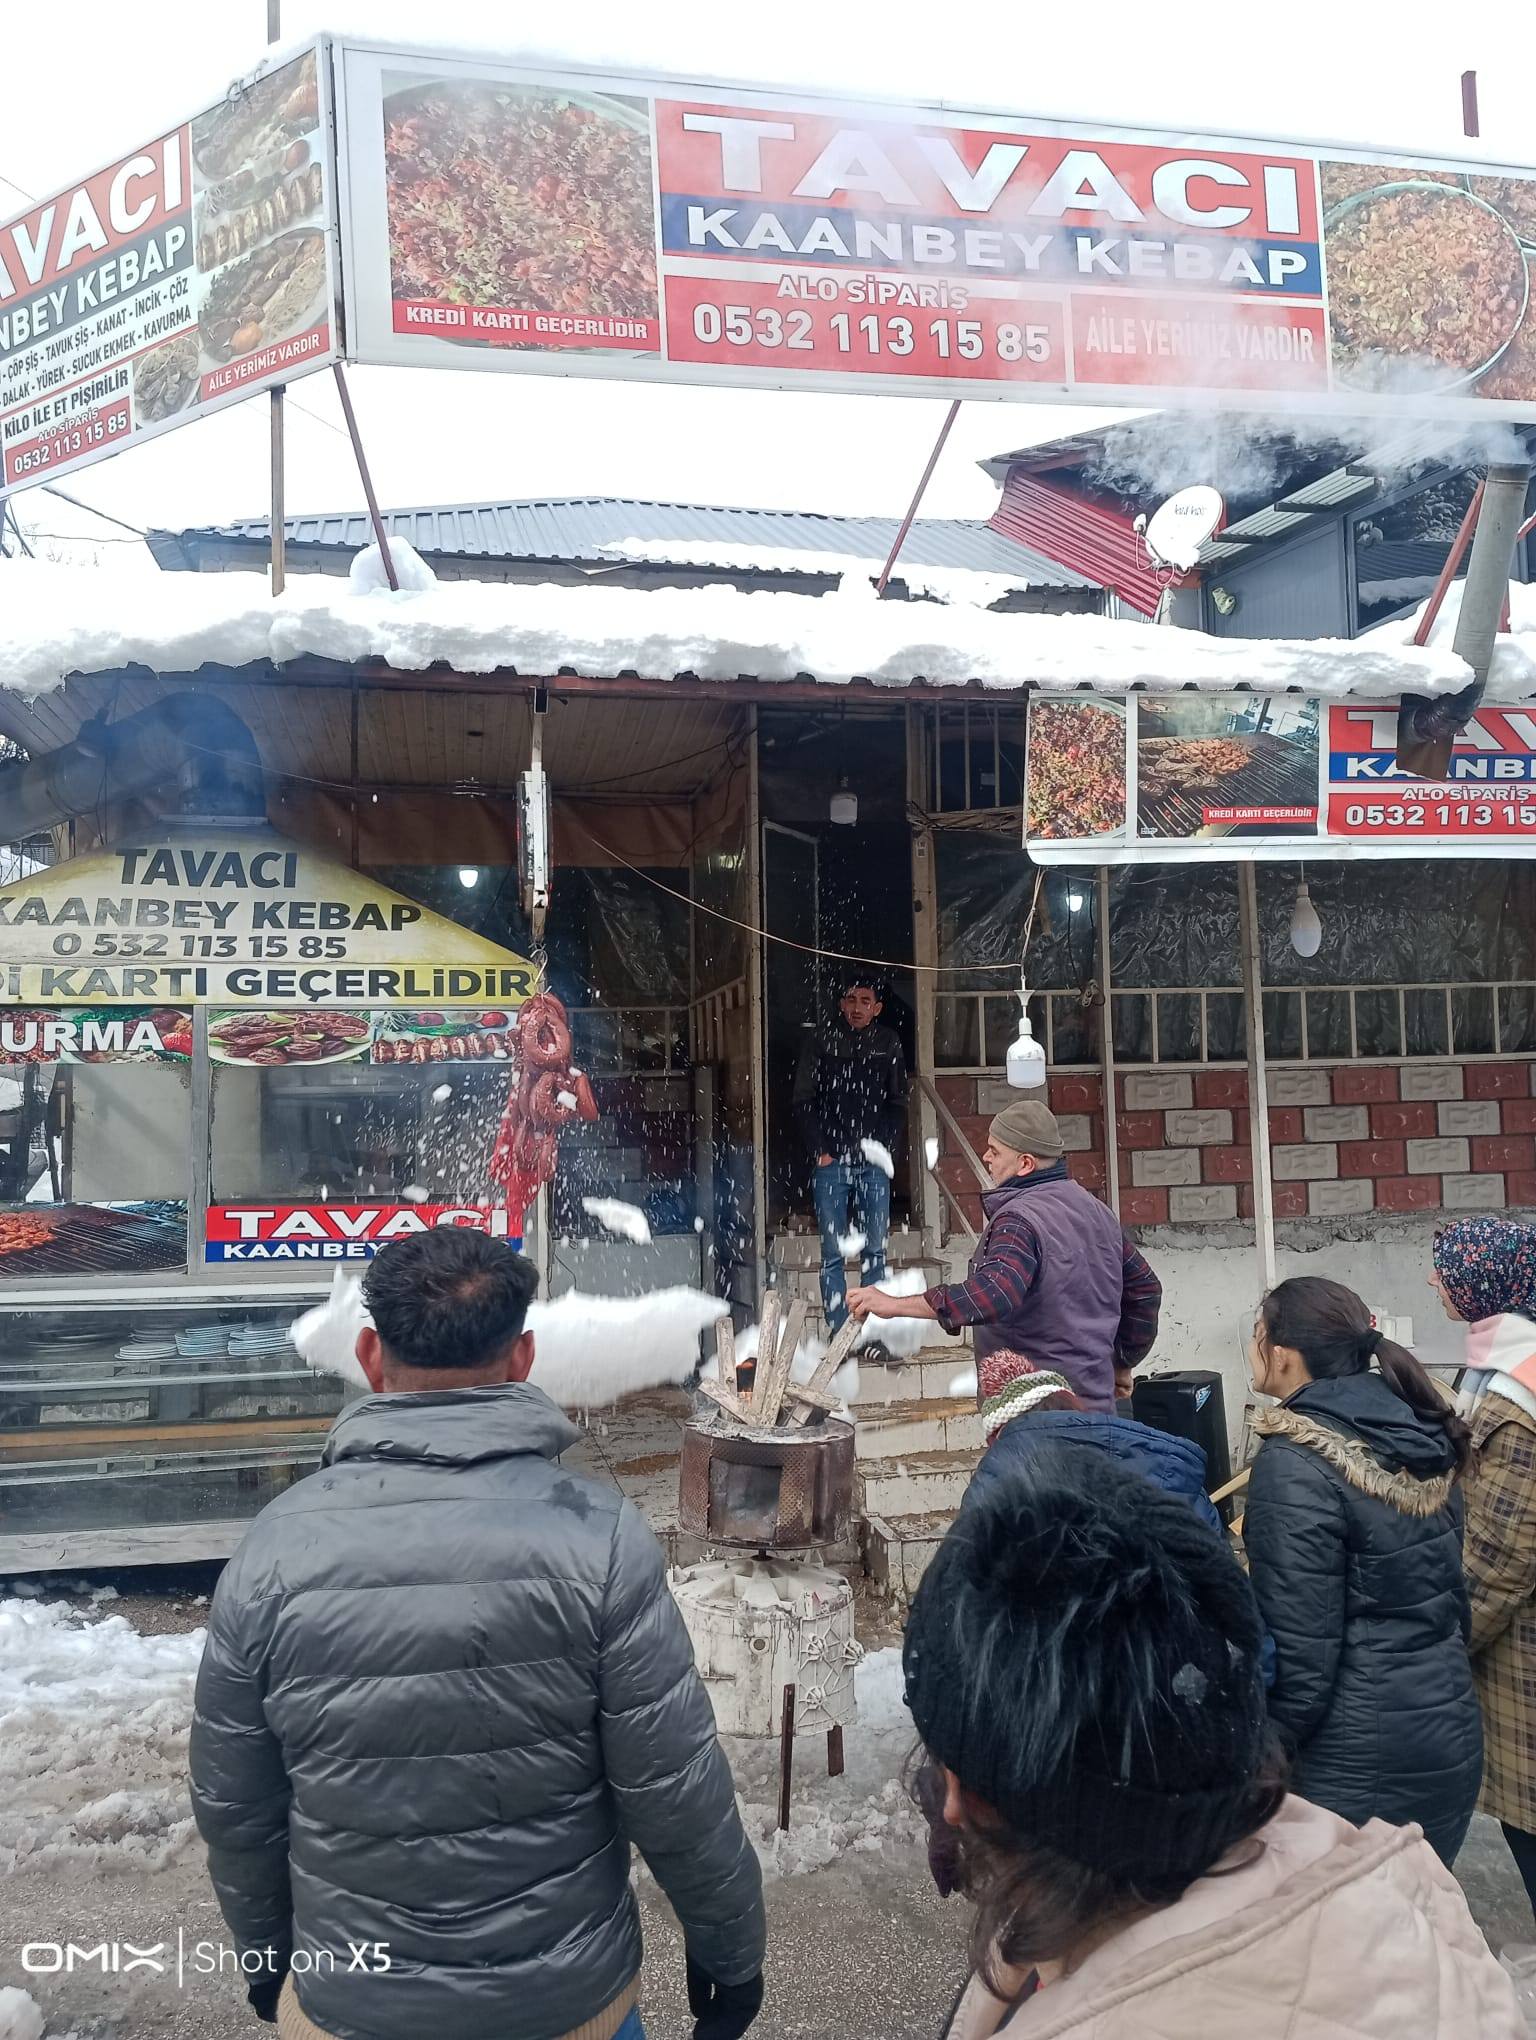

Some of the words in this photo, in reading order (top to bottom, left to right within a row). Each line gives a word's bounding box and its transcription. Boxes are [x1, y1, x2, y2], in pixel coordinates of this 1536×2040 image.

[682, 112, 1301, 235] TAVACI
[0, 133, 182, 300] VACI
[687, 205, 1054, 270] KAANBEY
[1075, 235, 1308, 286] KEBAP
[77, 225, 187, 315] KEBAP
[776, 273, 839, 301] ALO
[406, 306, 466, 326] KREDİ
[472, 311, 529, 331] KARTI
[692, 302, 815, 351] 0532
[830, 312, 915, 356] 113
[929, 318, 984, 360] 15
[996, 323, 1051, 363] 85
[46, 334, 73, 362] TAVUK
[96, 308, 127, 337] KANAT
[279, 333, 320, 361] VARDIR
[1142, 311, 1231, 359] YERİİZ
[1234, 324, 1315, 362] VARDIR
[3, 381, 30, 407] DALAK
[36, 365, 65, 391] YÜREK
[72, 345, 103, 375] SUCUK
[103, 331, 136, 364] EKMEK
[143, 304, 192, 341] KAVURMA
[54, 397, 68, 417] ET
[14, 445, 51, 474] 0532
[53, 432, 81, 459] 113
[85, 421, 104, 445] 15
[107, 410, 128, 435] 85
[37, 425, 57, 444] ALO
[1402, 788, 1444, 801] ALO
[1236, 808, 1260, 818] KARTI
[1345, 804, 1425, 826] 0532
[1436, 804, 1493, 826] 113
[1502, 804, 1536, 826] 15
[115, 848, 297, 888] TAVACI
[253, 901, 422, 931] KEBAP
[52, 933, 82, 956] 0
[92, 933, 169, 956] 532
[180, 935, 237, 957] 113
[249, 935, 288, 957] 15
[298, 936, 347, 958] 85
[41, 967, 207, 997] KARTI
[1, 1020, 165, 1051] URMA
[223, 1243, 389, 1258] KAANBEY
